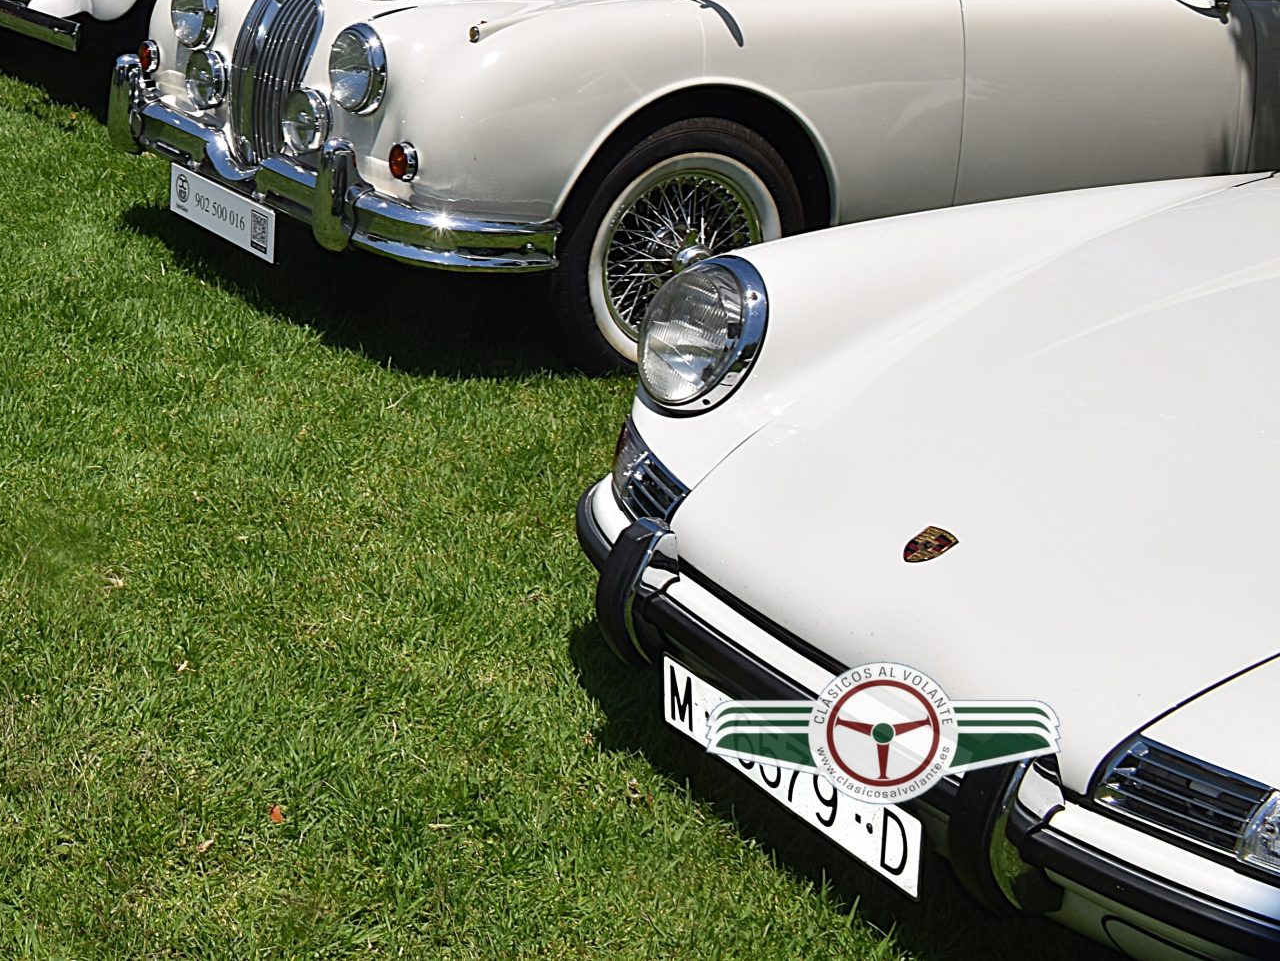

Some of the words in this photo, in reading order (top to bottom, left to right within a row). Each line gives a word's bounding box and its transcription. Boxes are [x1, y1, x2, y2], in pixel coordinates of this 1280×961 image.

[195, 192, 210, 213] 902
[212, 202, 228, 221] 500
[229, 210, 245, 231] 016
[670, 665, 693, 732] M
